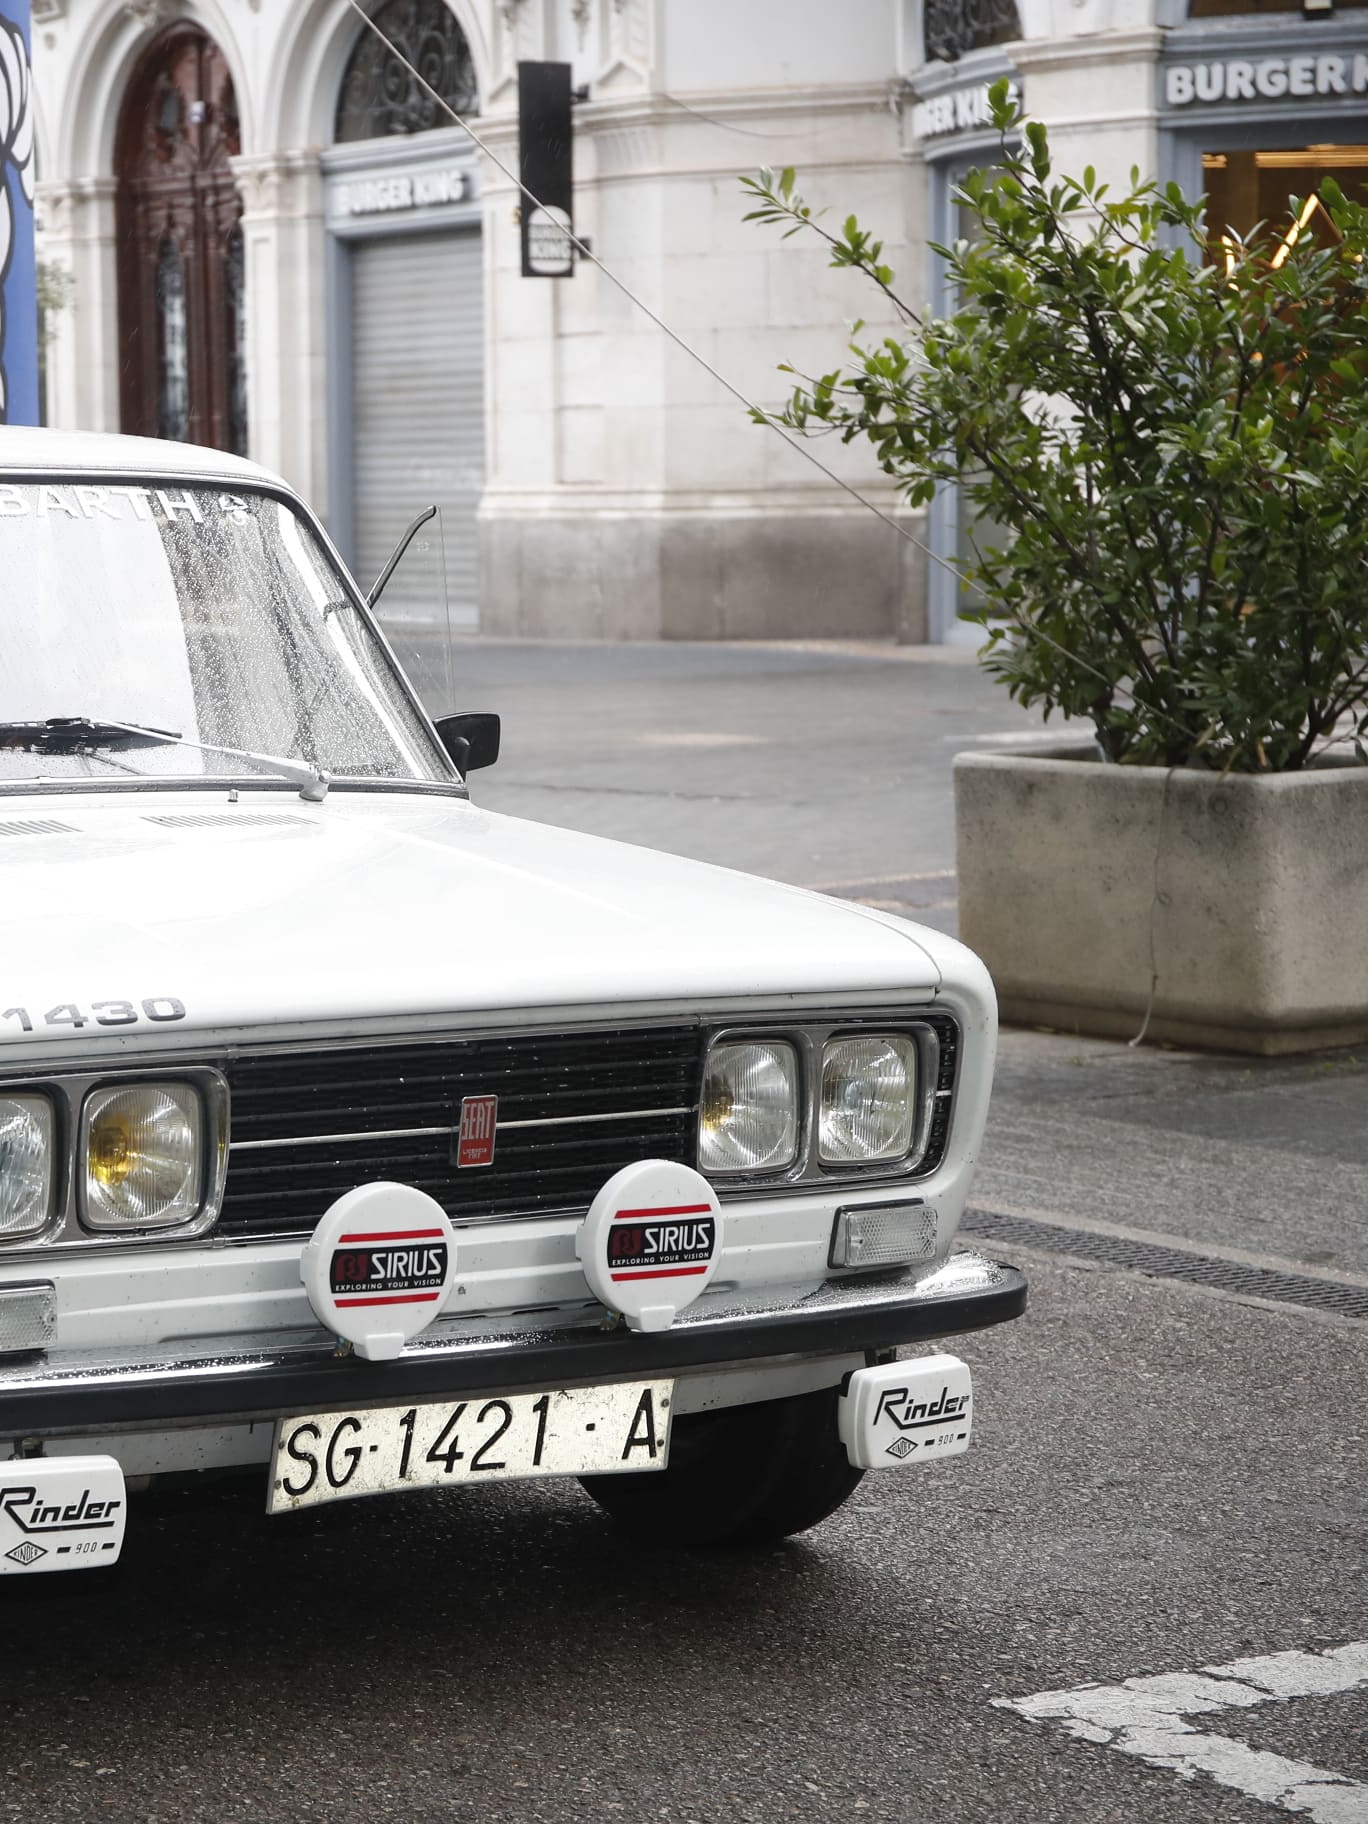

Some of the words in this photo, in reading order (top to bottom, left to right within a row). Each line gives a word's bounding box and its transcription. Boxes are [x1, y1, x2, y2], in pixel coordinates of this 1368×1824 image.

[1166, 55, 1346, 104] BURGER
[414, 170, 465, 205] KING
[1, 997, 186, 1032] 1430
[461, 1101, 495, 1140] SEAT
[643, 1223, 711, 1254] SIRIUS
[370, 1248, 443, 1280] SIRIUS
[612, 1256, 655, 1266] EXPLORING
[659, 1254, 680, 1262] YOUR
[335, 1282, 383, 1292] EXPLORING
[388, 1281, 409, 1289] YOUR
[414, 1278, 441, 1287] VISION
[873, 1386, 970, 1430] Rinder
[75, 1541, 97, 1554] 900
